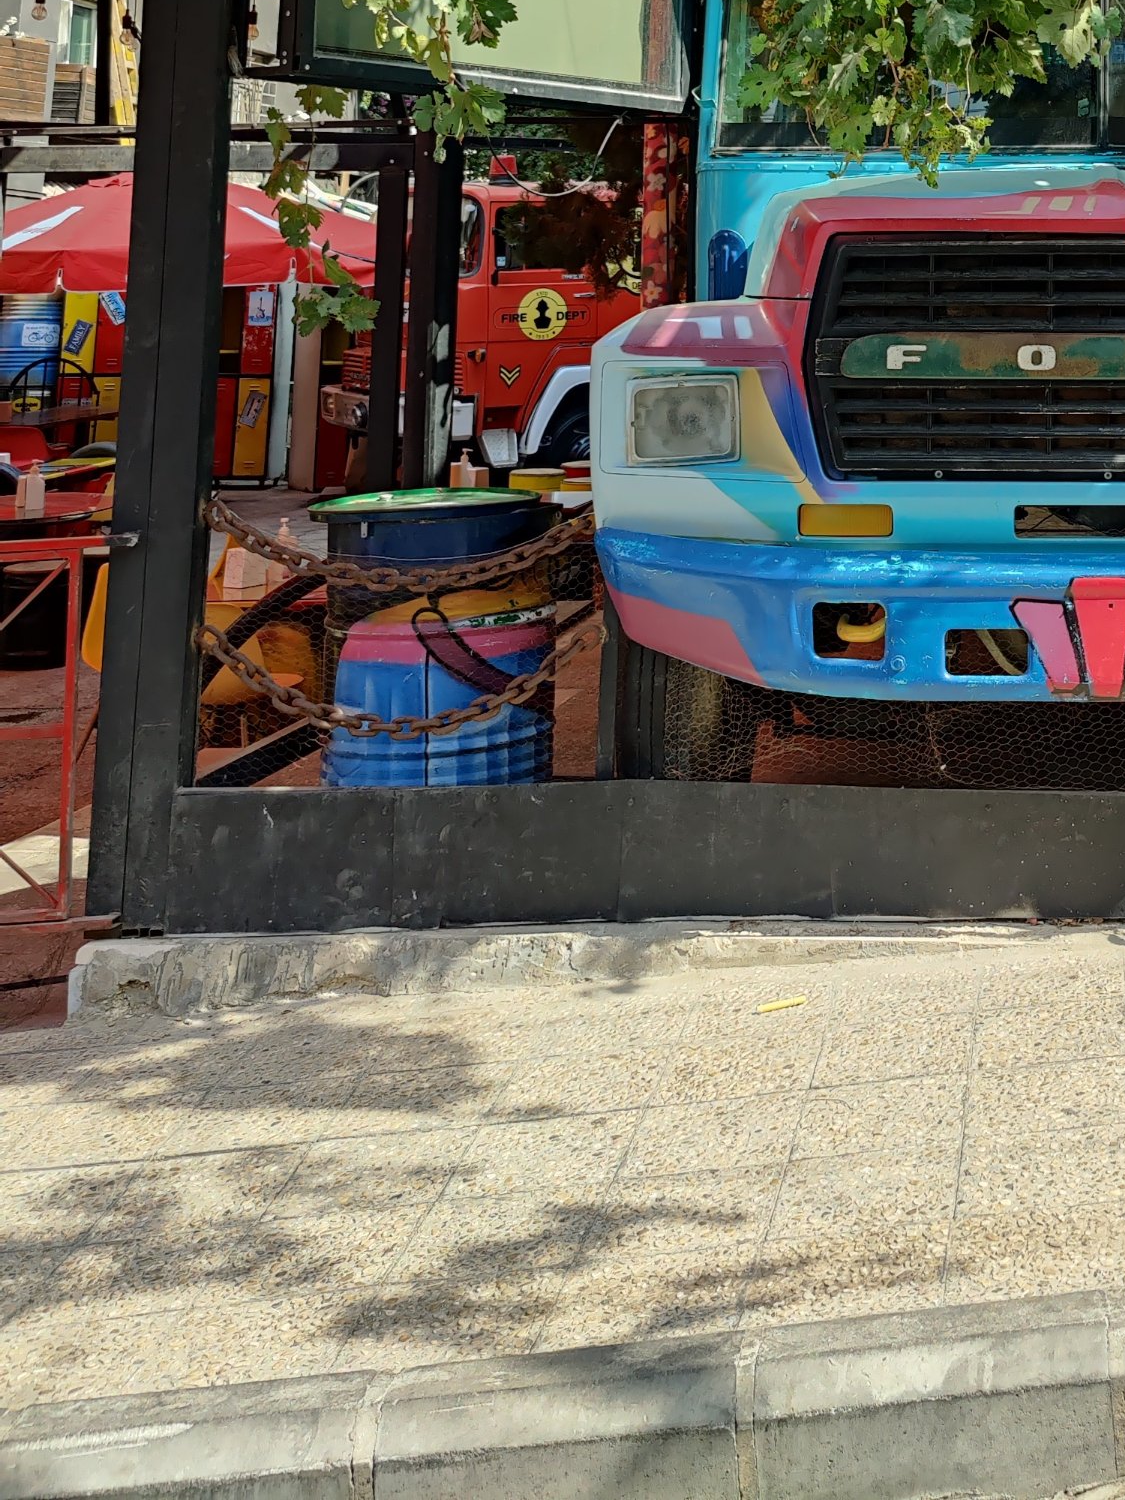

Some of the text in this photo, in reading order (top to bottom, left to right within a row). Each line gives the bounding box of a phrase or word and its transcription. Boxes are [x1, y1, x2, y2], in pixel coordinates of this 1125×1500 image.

[501, 310, 587, 324] FIRE DEPT
[70, 324, 87, 350] FAMILY
